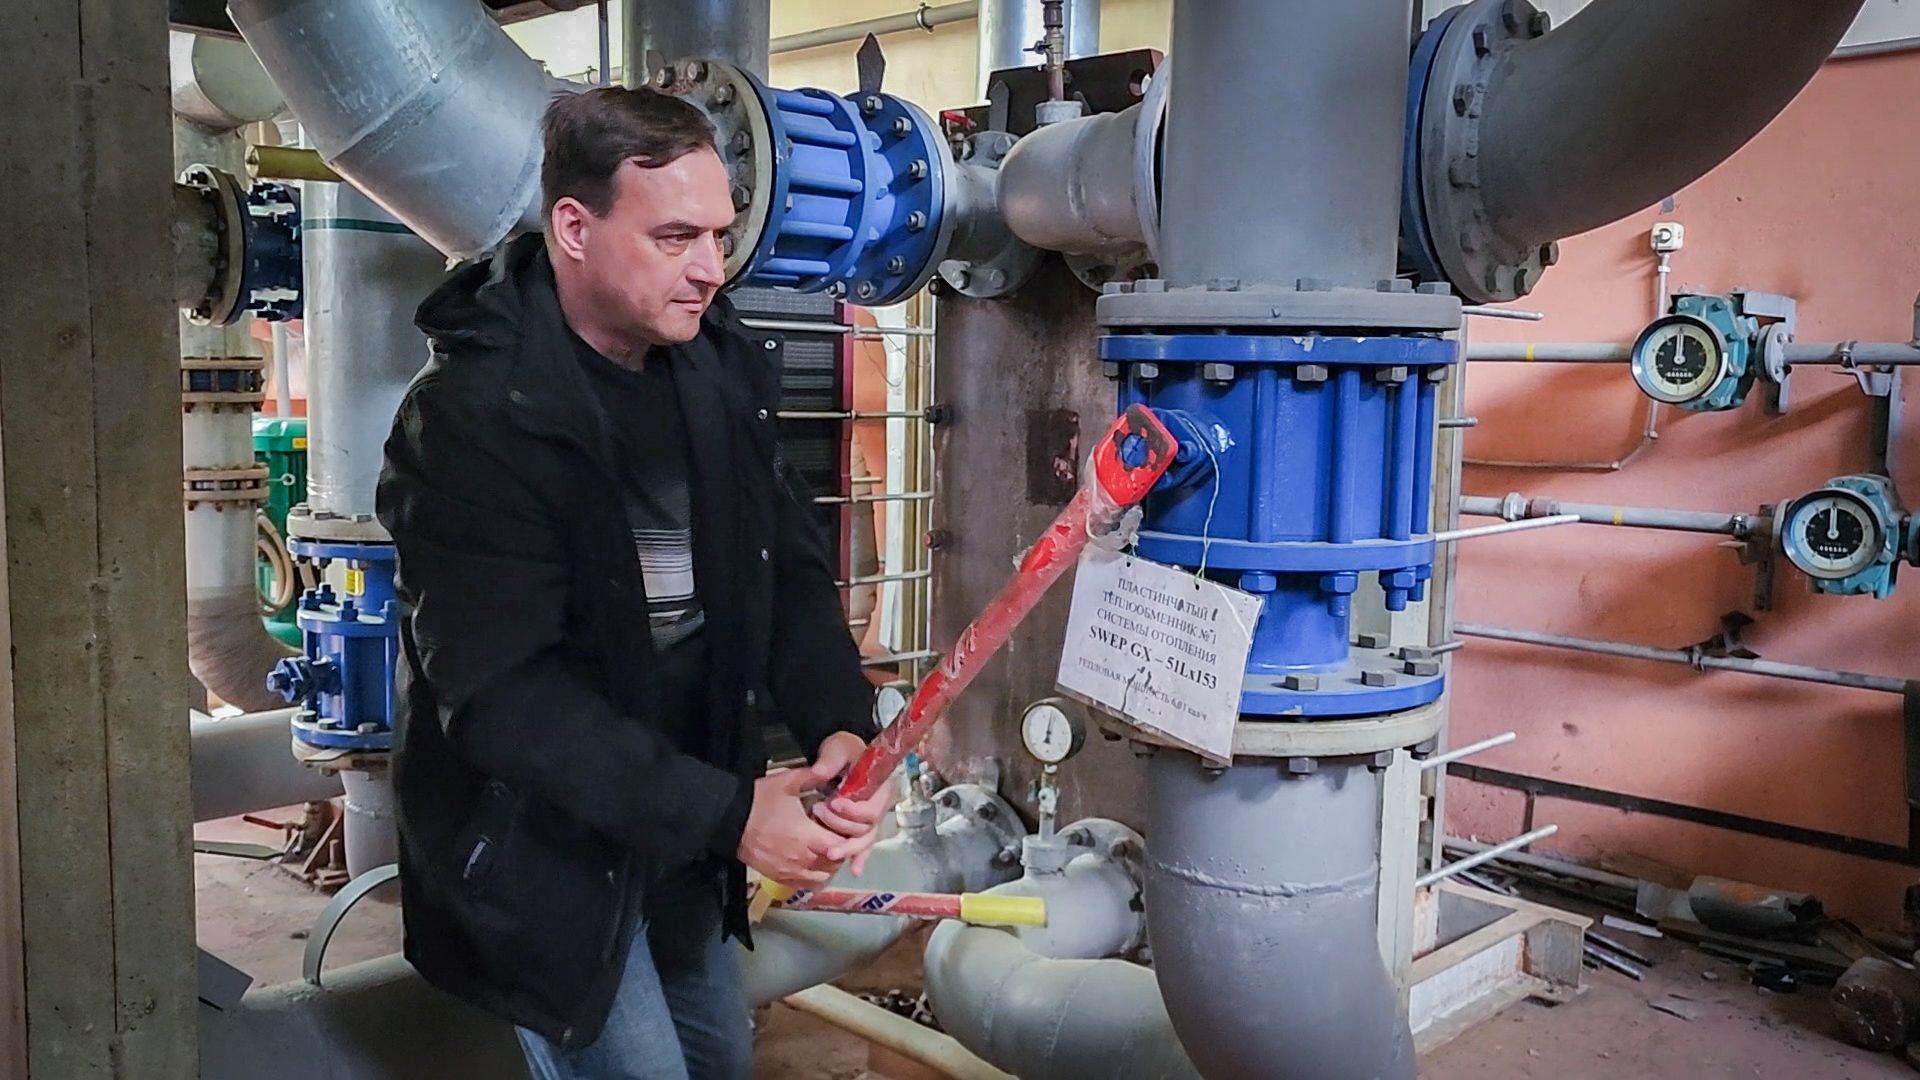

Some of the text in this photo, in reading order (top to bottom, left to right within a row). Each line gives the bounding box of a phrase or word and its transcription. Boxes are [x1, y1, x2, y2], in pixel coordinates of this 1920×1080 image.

[1103, 591, 1198, 636] ТЕПЛООБМЕННИК
[1117, 578, 1208, 620] ПЛАСТИНЧАТЫЙ
[1089, 625, 1128, 651] SWEP
[1130, 642, 1153, 662] GX
[1096, 607, 1217, 665] СИСТЕМЫ ОТОПЛЕНИЯ
